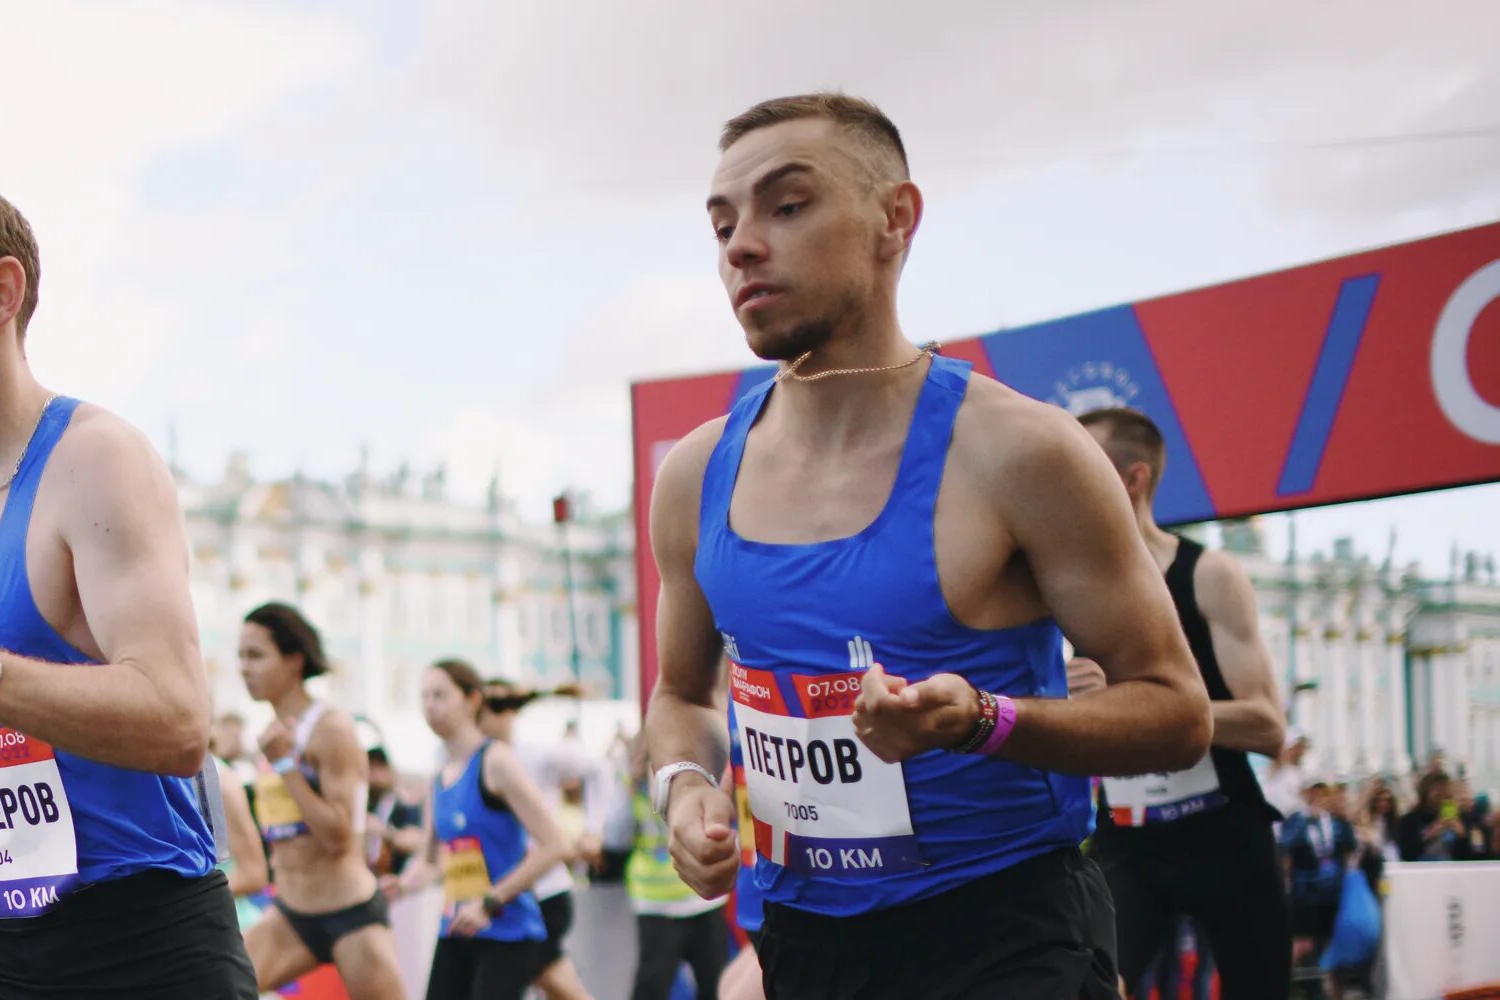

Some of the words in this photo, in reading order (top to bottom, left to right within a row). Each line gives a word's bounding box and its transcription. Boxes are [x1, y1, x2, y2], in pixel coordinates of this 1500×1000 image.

[807, 676, 861, 697] 07.08
[746, 726, 863, 785] ПЕТРОВ
[784, 801, 819, 821] 7005
[806, 848, 833, 869] 10
[4, 888, 26, 910] 10
